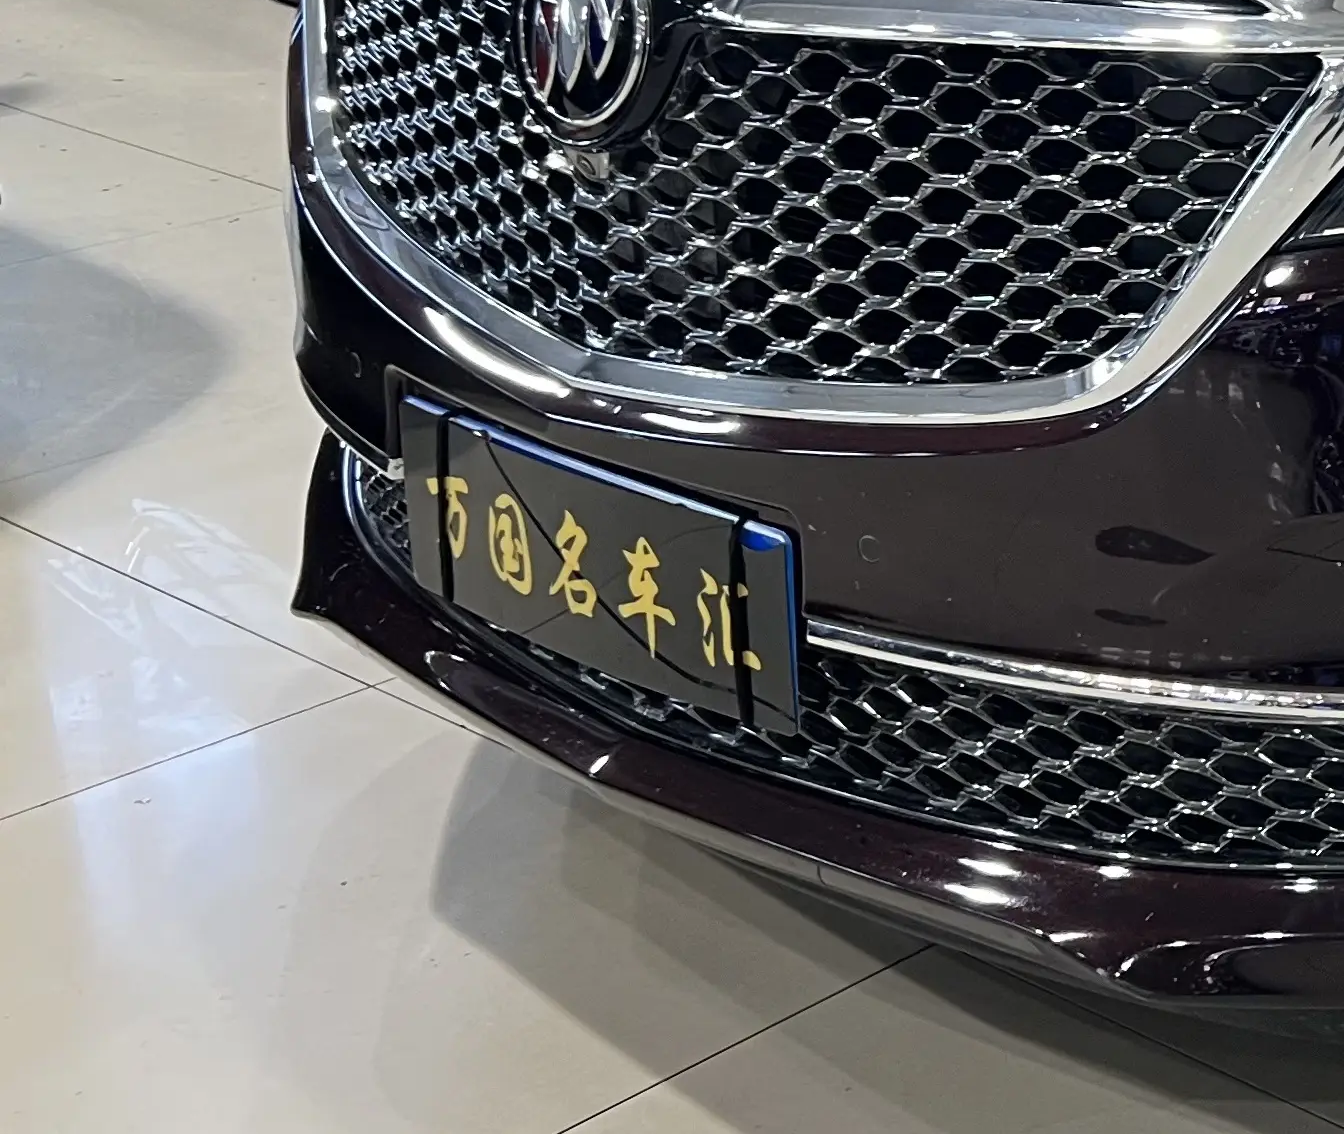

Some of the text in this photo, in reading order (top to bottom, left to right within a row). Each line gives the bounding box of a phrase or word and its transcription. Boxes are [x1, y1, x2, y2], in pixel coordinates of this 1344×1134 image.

[427, 475, 762, 671] 万国名车汇
